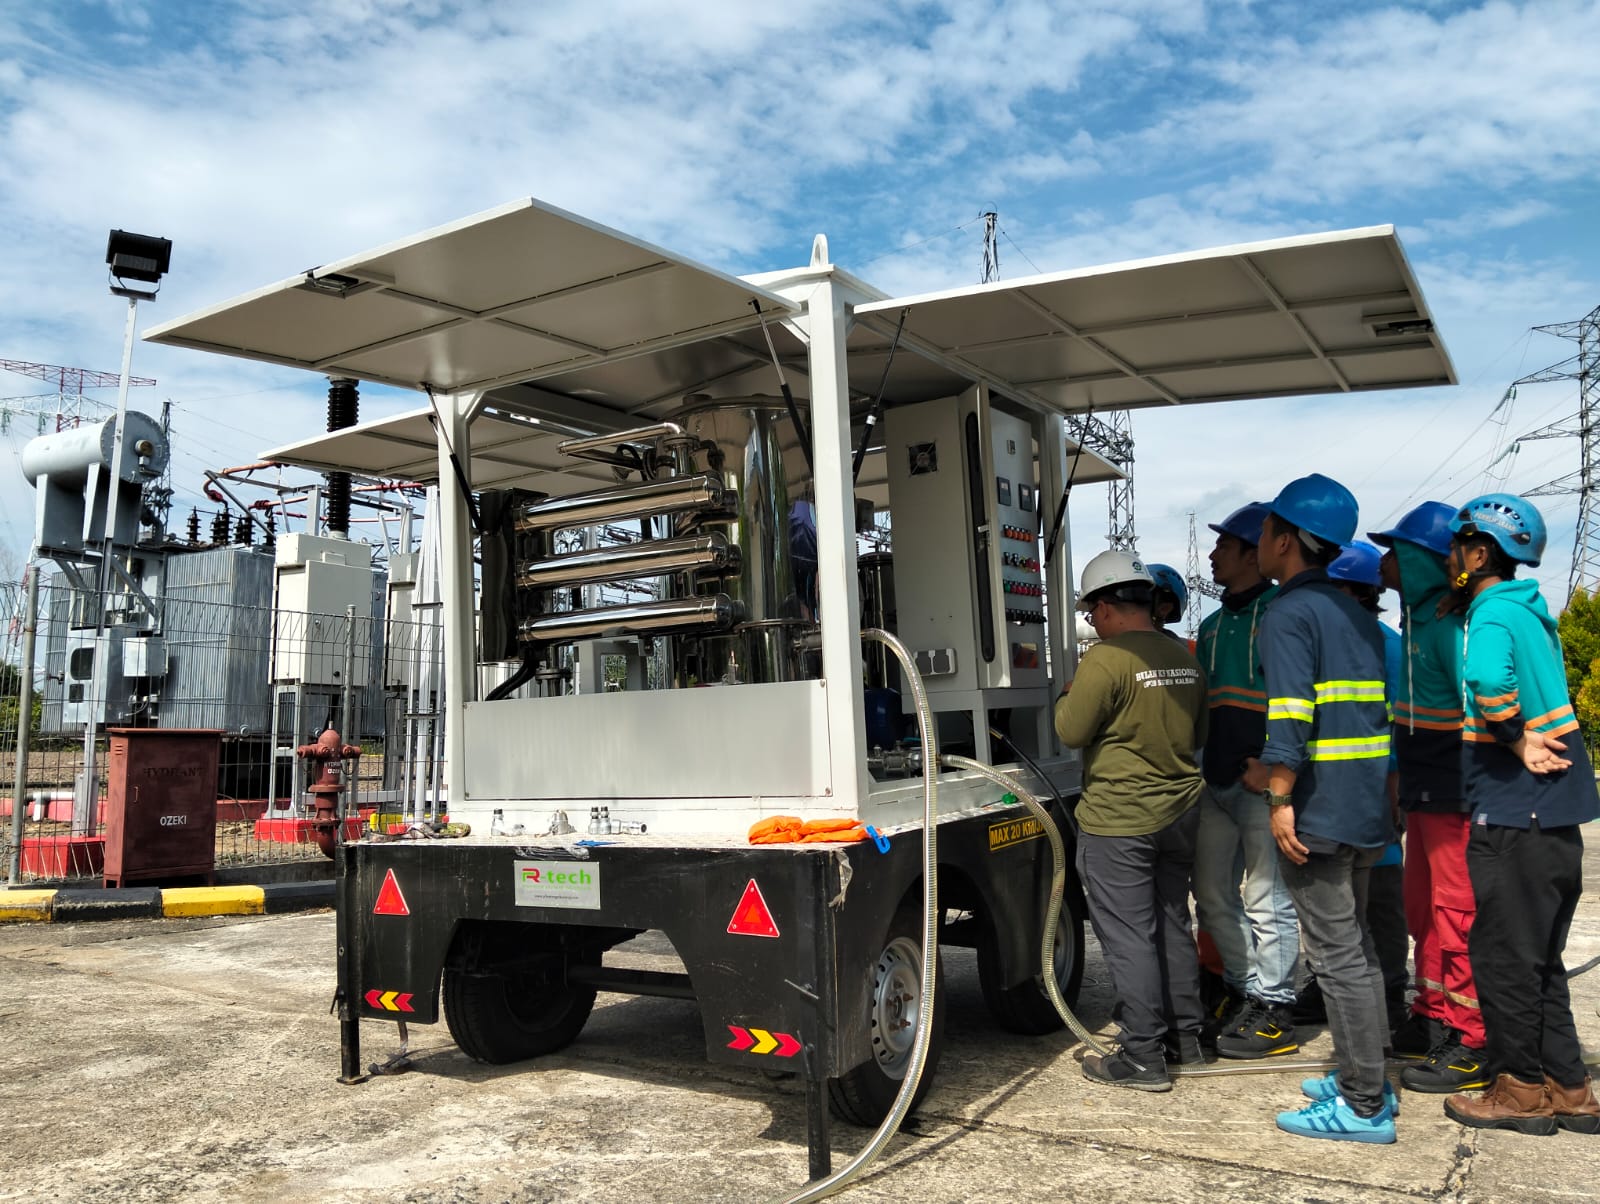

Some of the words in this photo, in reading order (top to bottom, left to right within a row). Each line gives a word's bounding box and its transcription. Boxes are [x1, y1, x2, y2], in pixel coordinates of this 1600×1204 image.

[160, 815, 187, 826] OZEKI
[990, 826, 1010, 846] MAX
[1011, 823, 1021, 840] 20
[522, 868, 592, 884] R-tech
